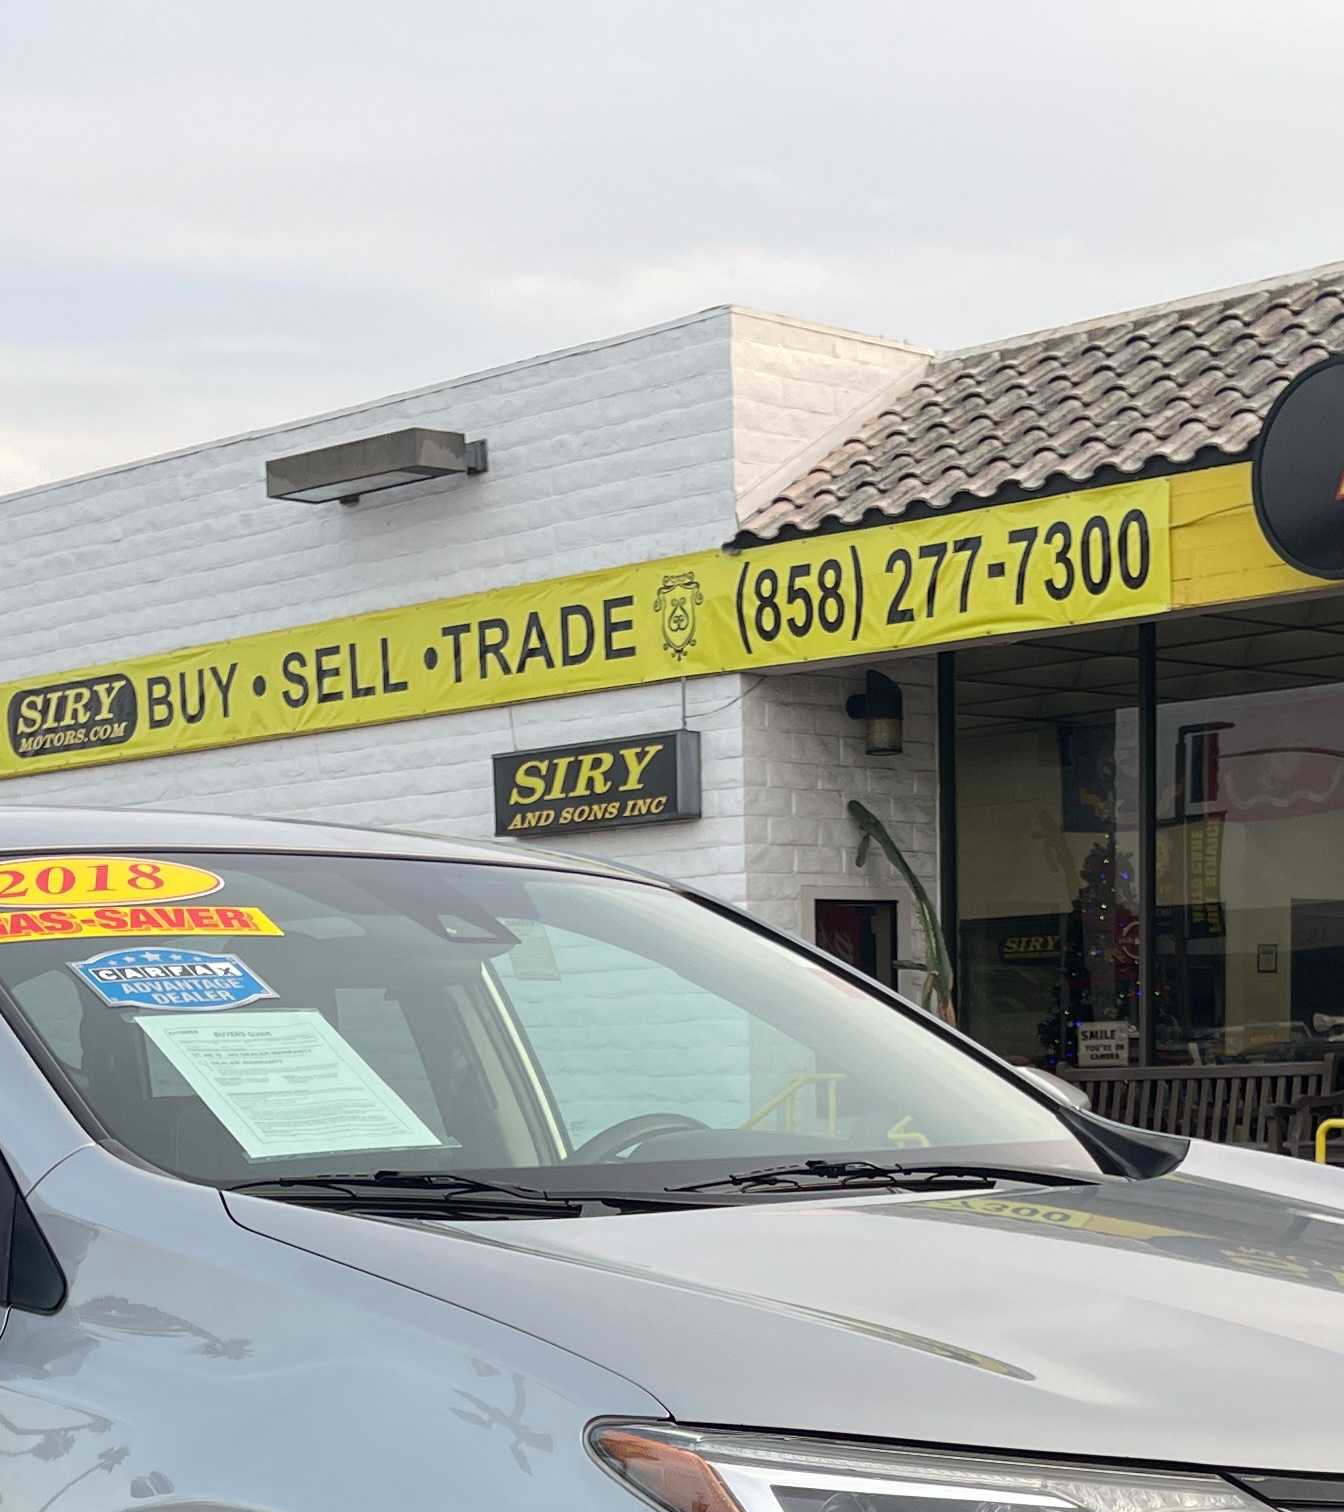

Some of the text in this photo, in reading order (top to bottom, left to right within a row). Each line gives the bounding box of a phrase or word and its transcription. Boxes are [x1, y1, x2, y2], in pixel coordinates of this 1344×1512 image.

[736, 508, 1150, 655] (858) 277-7300
[148, 595, 638, 729] BUY SELL TRADE
[17, 680, 124, 735] SIRY
[20, 722, 127, 752] MOTORS.COM
[506, 744, 663, 806] SIRY
[506, 795, 668, 831] AND SONS INC
[96, 964, 238, 981] CARFAX
[120, 978, 244, 995] ADVANTAGE
[151, 991, 234, 1005] DEALER
[1081, 1029, 1116, 1041] SMILE
